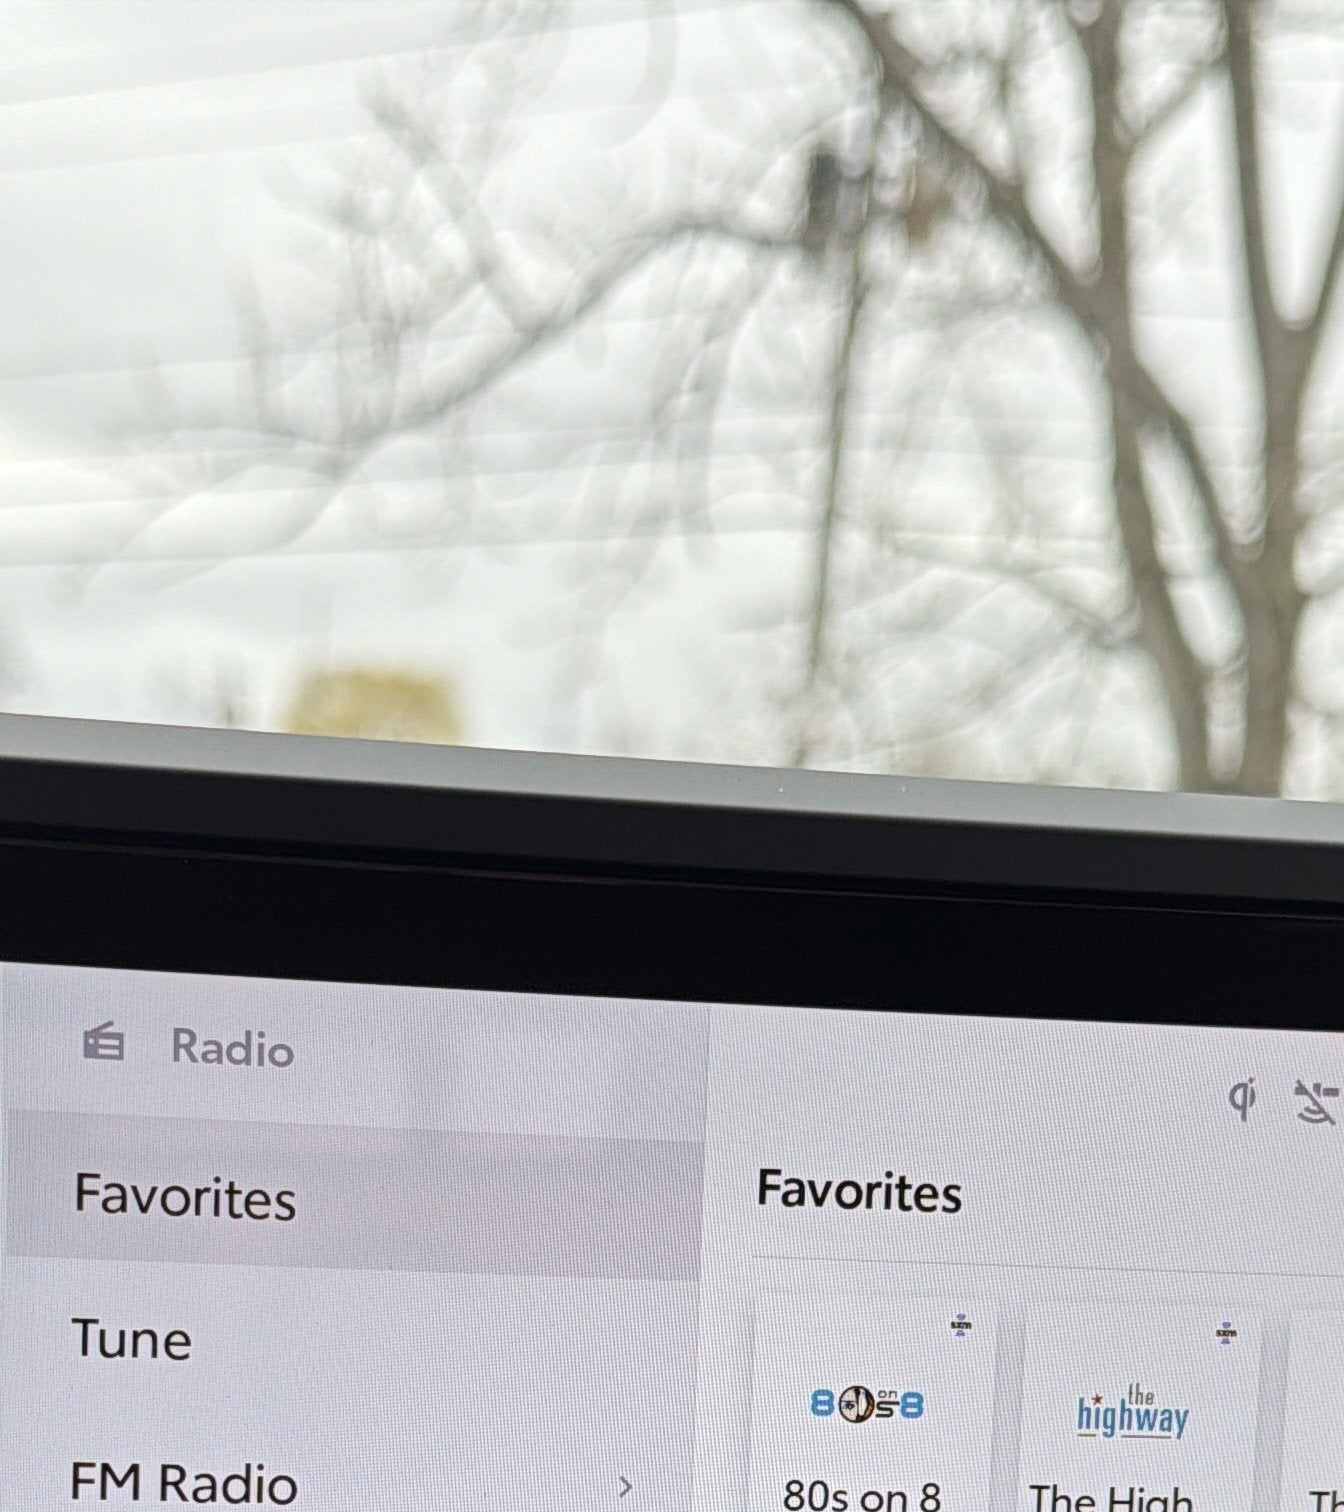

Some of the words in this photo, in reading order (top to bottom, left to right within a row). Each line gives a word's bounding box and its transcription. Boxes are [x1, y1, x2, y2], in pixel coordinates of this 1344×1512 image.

[171, 1025, 296, 1068] Radio
[74, 1171, 297, 1222] Favorites
[757, 1168, 963, 1215] Favorites
[72, 1317, 193, 1363] Tune
[1077, 1393, 1190, 1440] highway
[1128, 1382, 1155, 1406] the
[70, 1462, 141, 1502] FM
[160, 1461, 298, 1506] Radio
